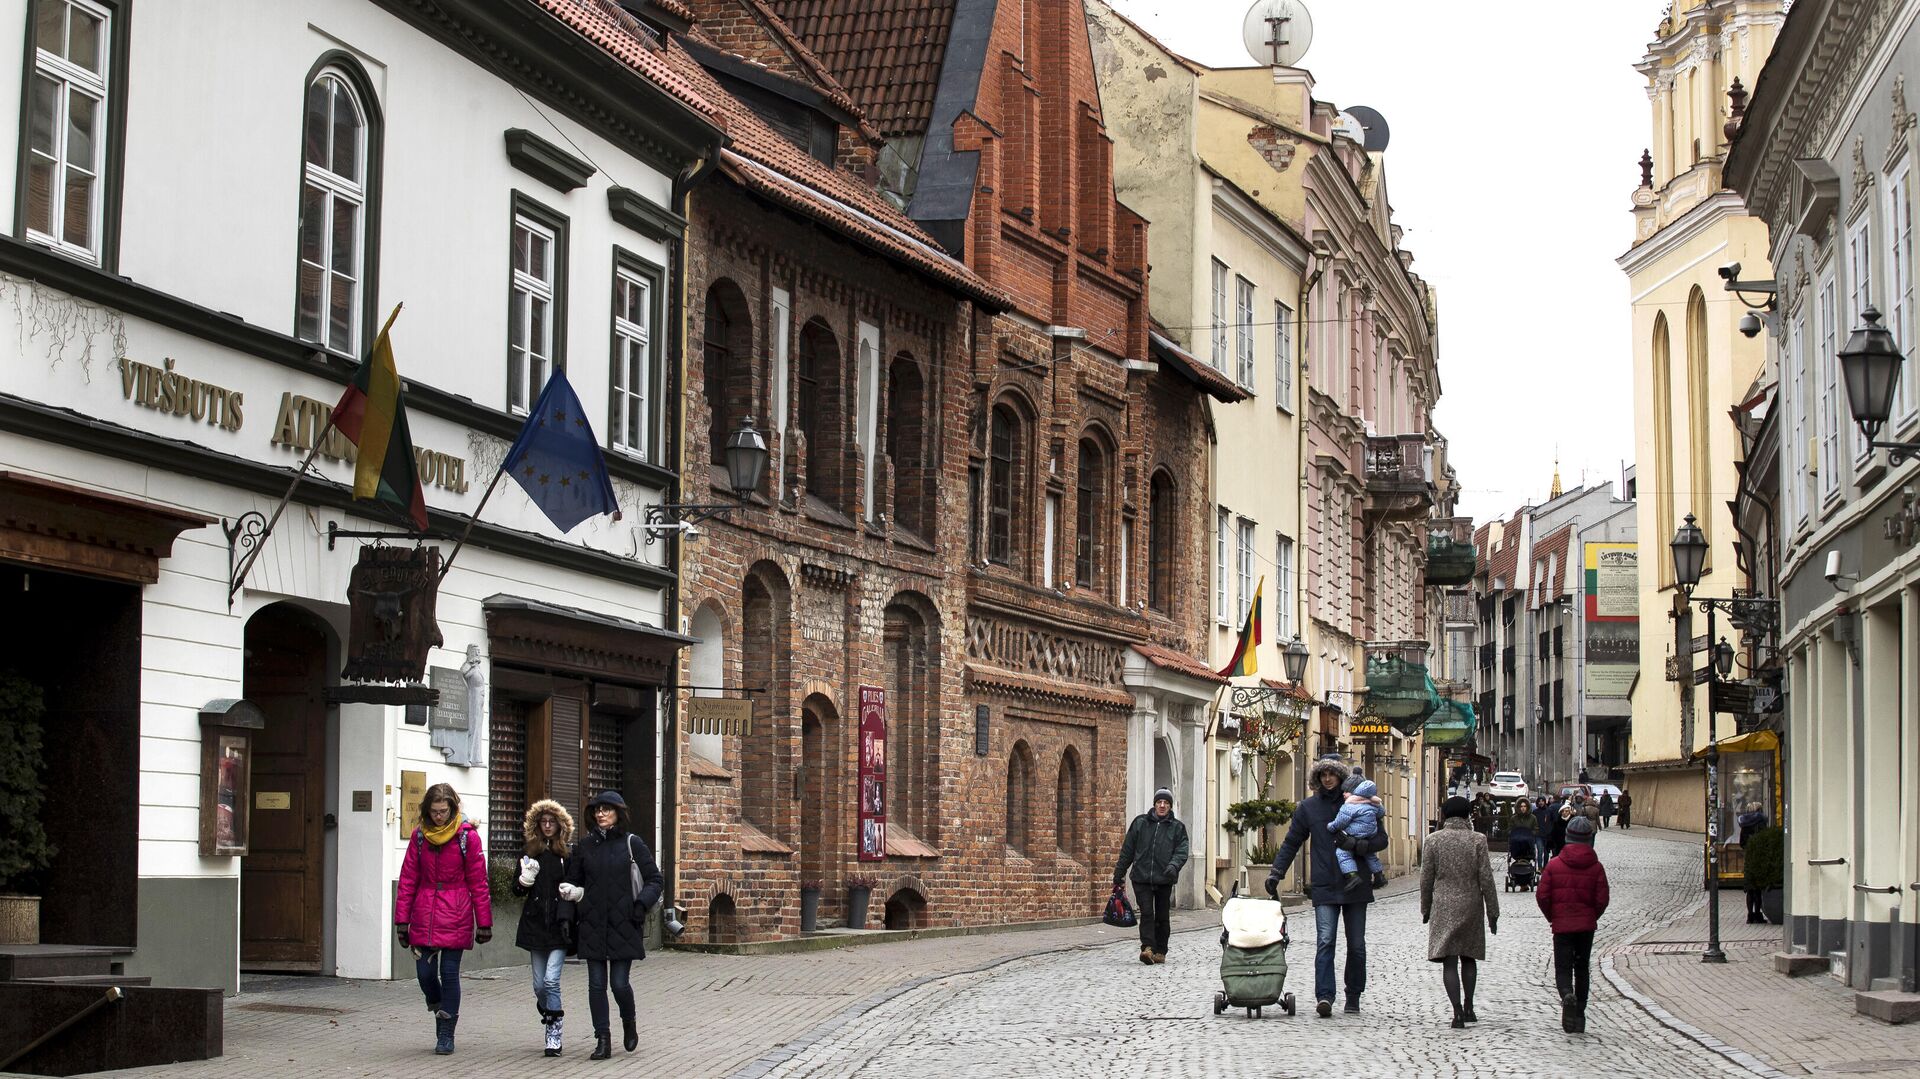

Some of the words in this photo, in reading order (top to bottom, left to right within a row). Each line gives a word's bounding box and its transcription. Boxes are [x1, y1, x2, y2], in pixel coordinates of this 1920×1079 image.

[119, 357, 244, 431] VIEŠBUTIS
[271, 391, 359, 462] ATRI
[1351, 725, 1389, 733] DVARAS
